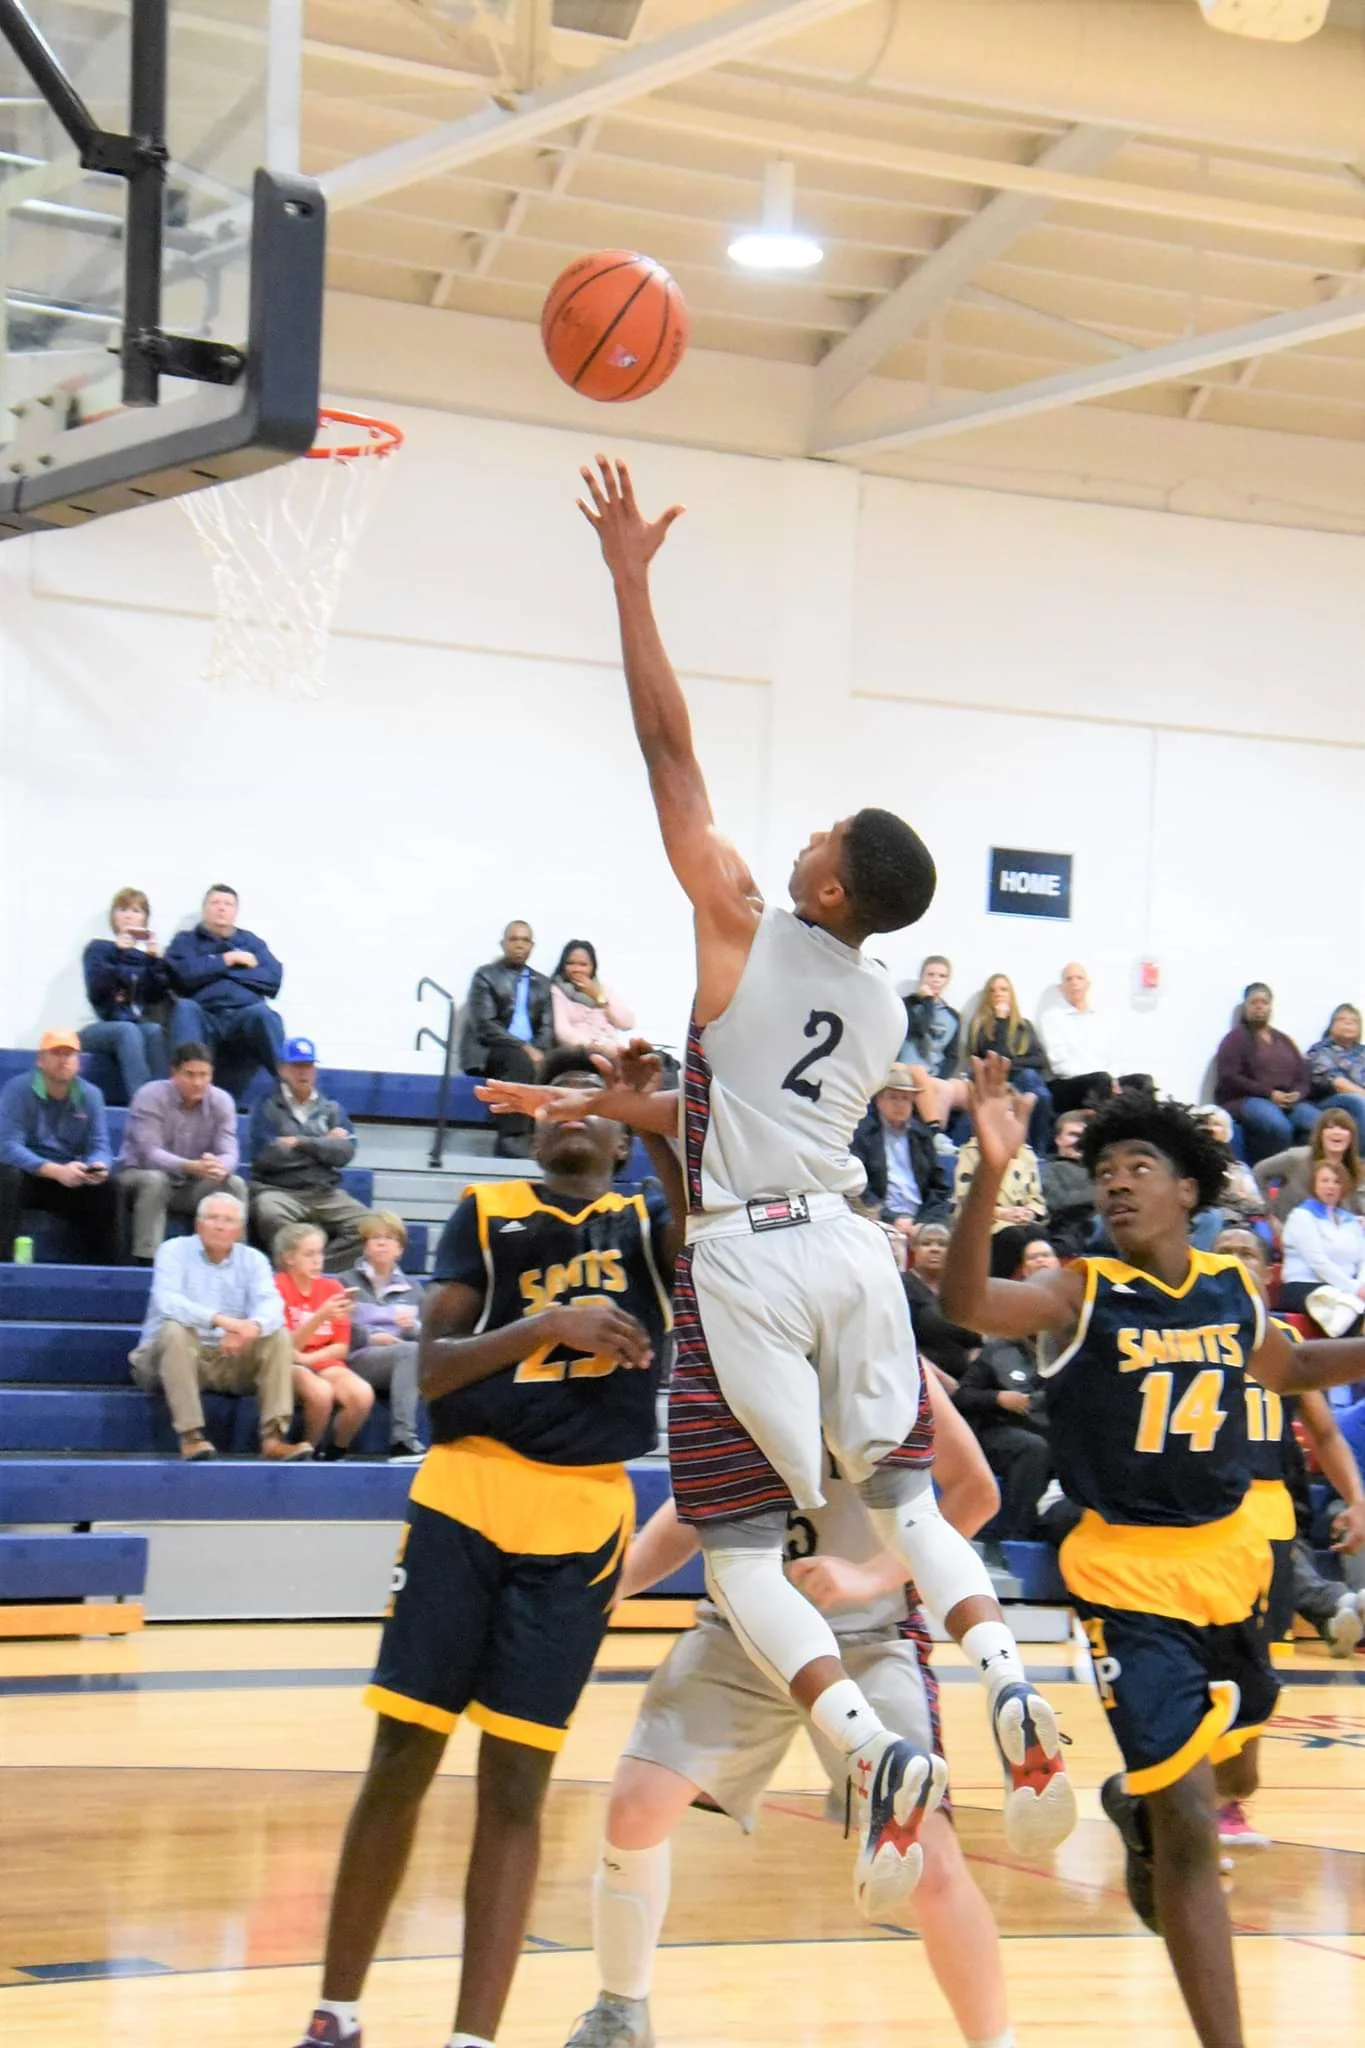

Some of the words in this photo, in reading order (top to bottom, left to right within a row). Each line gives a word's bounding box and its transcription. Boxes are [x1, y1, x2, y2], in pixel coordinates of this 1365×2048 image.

[1000, 870, 1062, 896] HOME
[781, 1009, 844, 1102] 2
[518, 1249, 628, 1316] SANTS
[1117, 1323, 1244, 1373] SAINTS
[1134, 1369, 1227, 1453] 14
